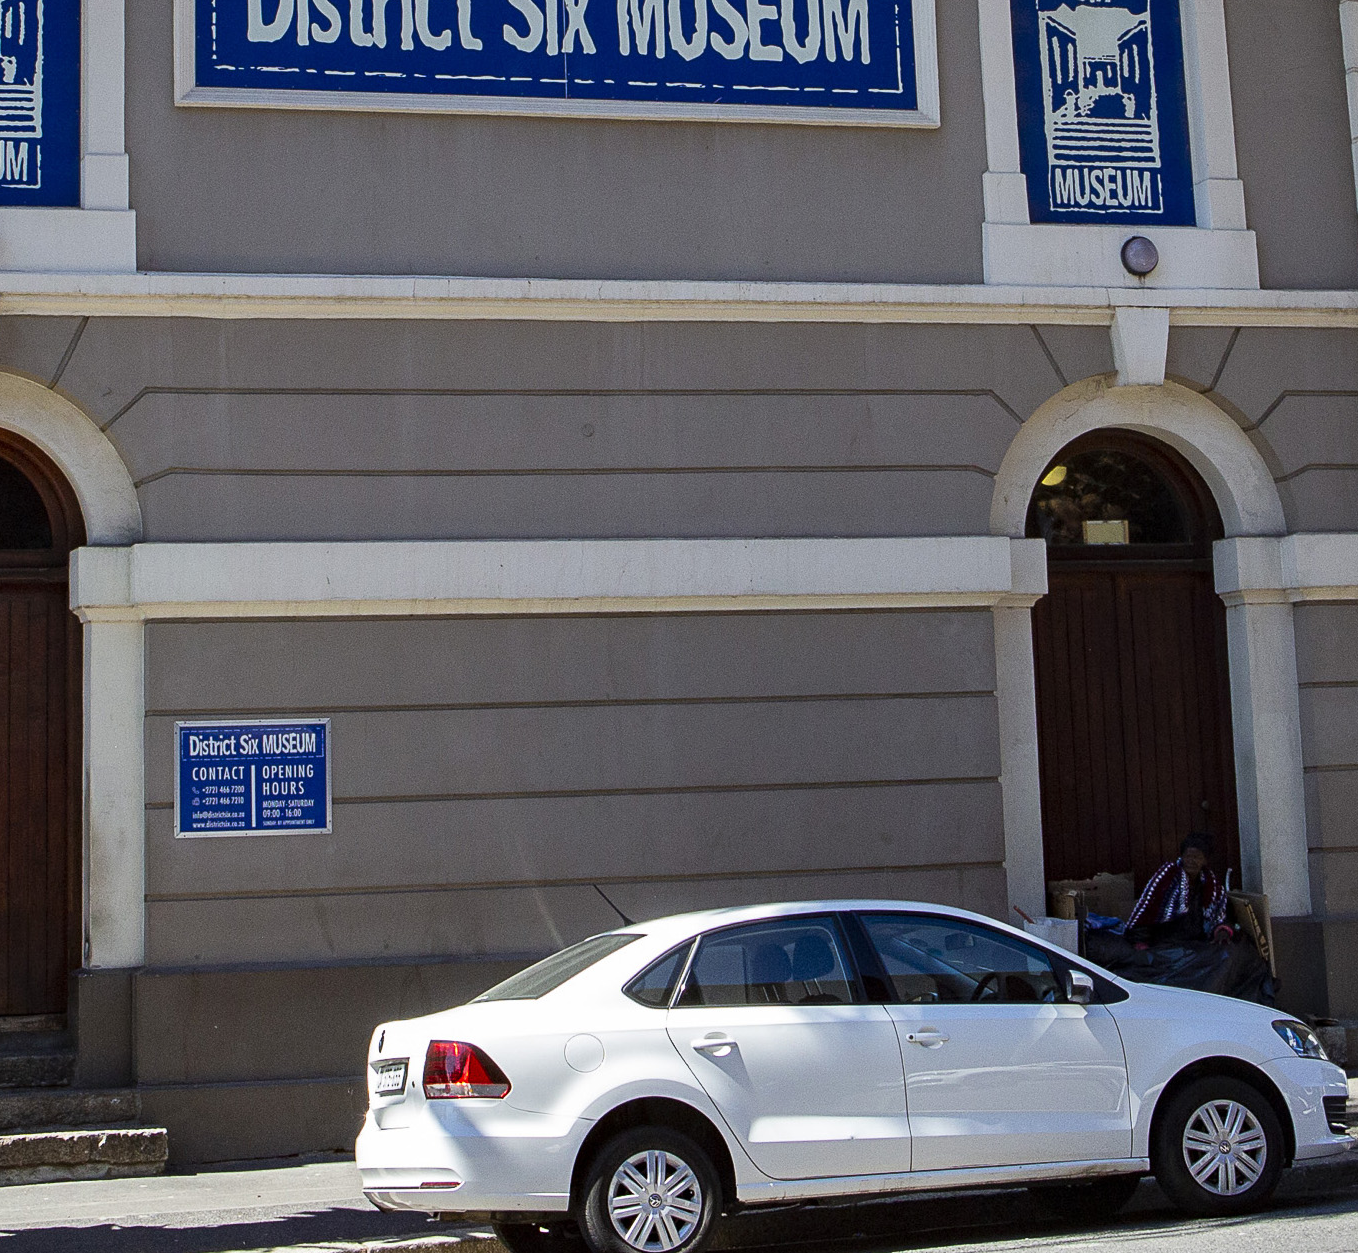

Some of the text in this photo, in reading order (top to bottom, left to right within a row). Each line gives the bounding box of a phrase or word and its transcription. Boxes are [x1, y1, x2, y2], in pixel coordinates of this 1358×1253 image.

[1054, 167, 1152, 207] MUSEUM
[189, 733, 316, 756] District Six MUSEUM
[192, 766, 245, 781] CONTACT
[262, 764, 314, 779] OPENING
[219, 786, 230, 794] 466
[231, 785, 245, 793] 7200
[263, 781, 305, 796] HOURS
[263, 809, 280, 818] 09:00
[286, 808, 302, 817] 16:00
